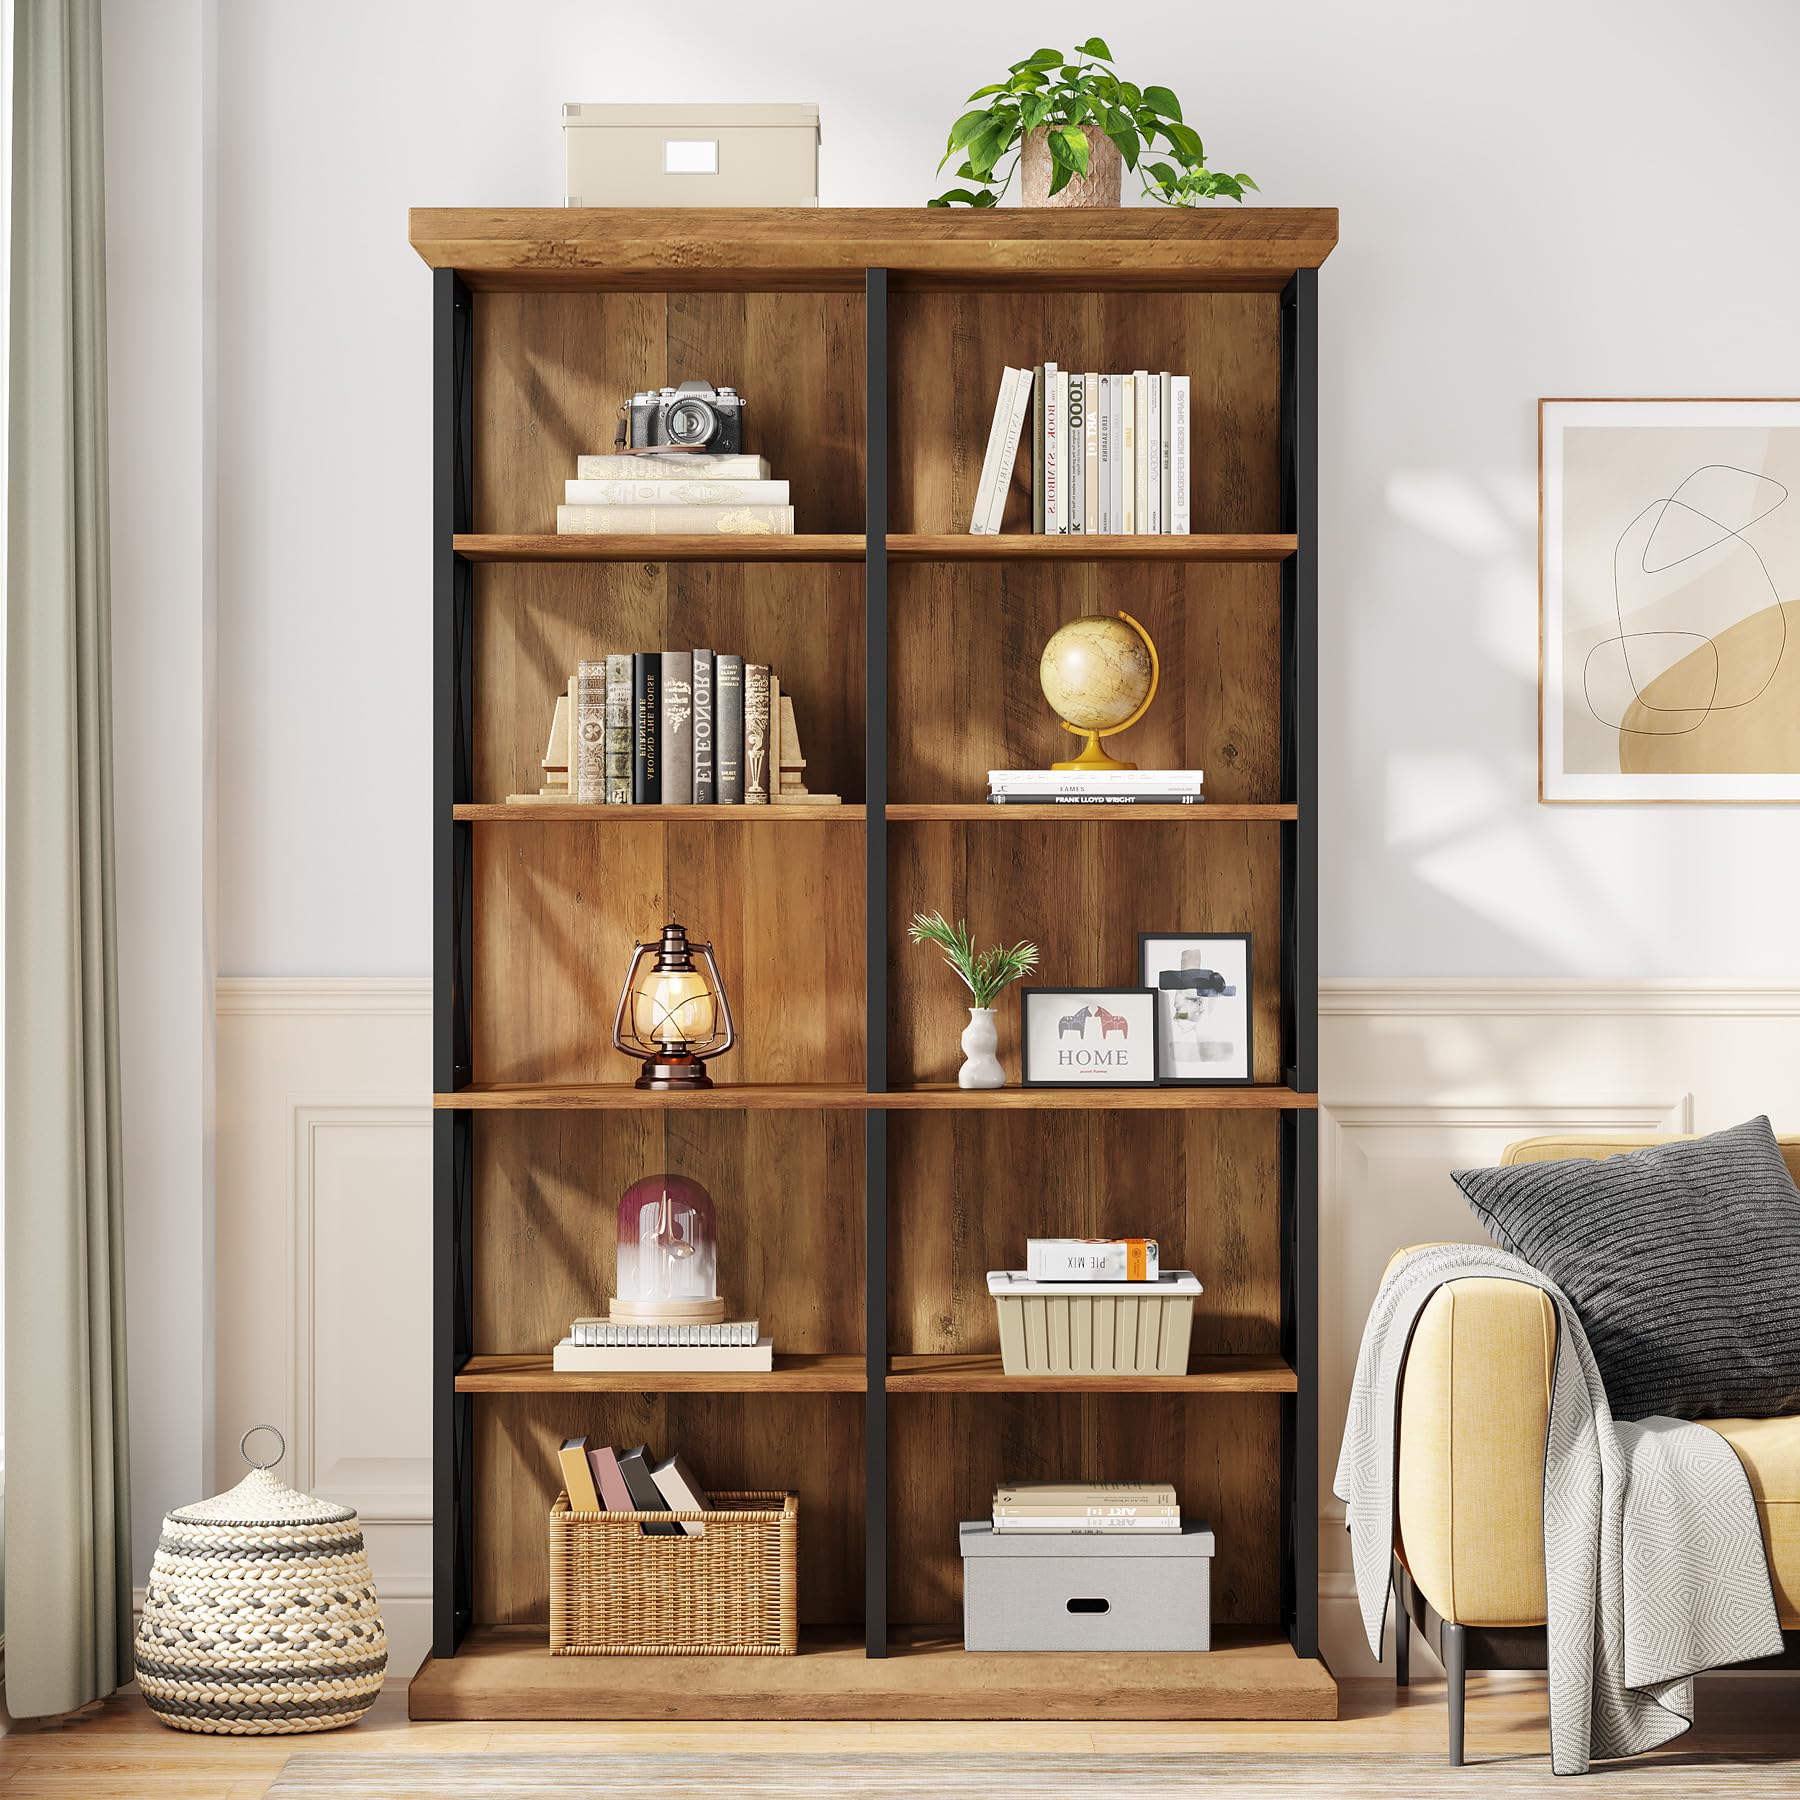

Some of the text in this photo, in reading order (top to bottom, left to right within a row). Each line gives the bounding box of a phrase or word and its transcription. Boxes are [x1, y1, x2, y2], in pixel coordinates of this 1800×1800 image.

[1055, 796, 1136, 804] FRANK LLOYD WRIGHT
[1058, 1050, 1129, 1066] HOME
[1067, 1257, 1105, 1268] PIE MIX
[1108, 1508, 1137, 1516] ART
[1108, 1518, 1137, 1526] ART
